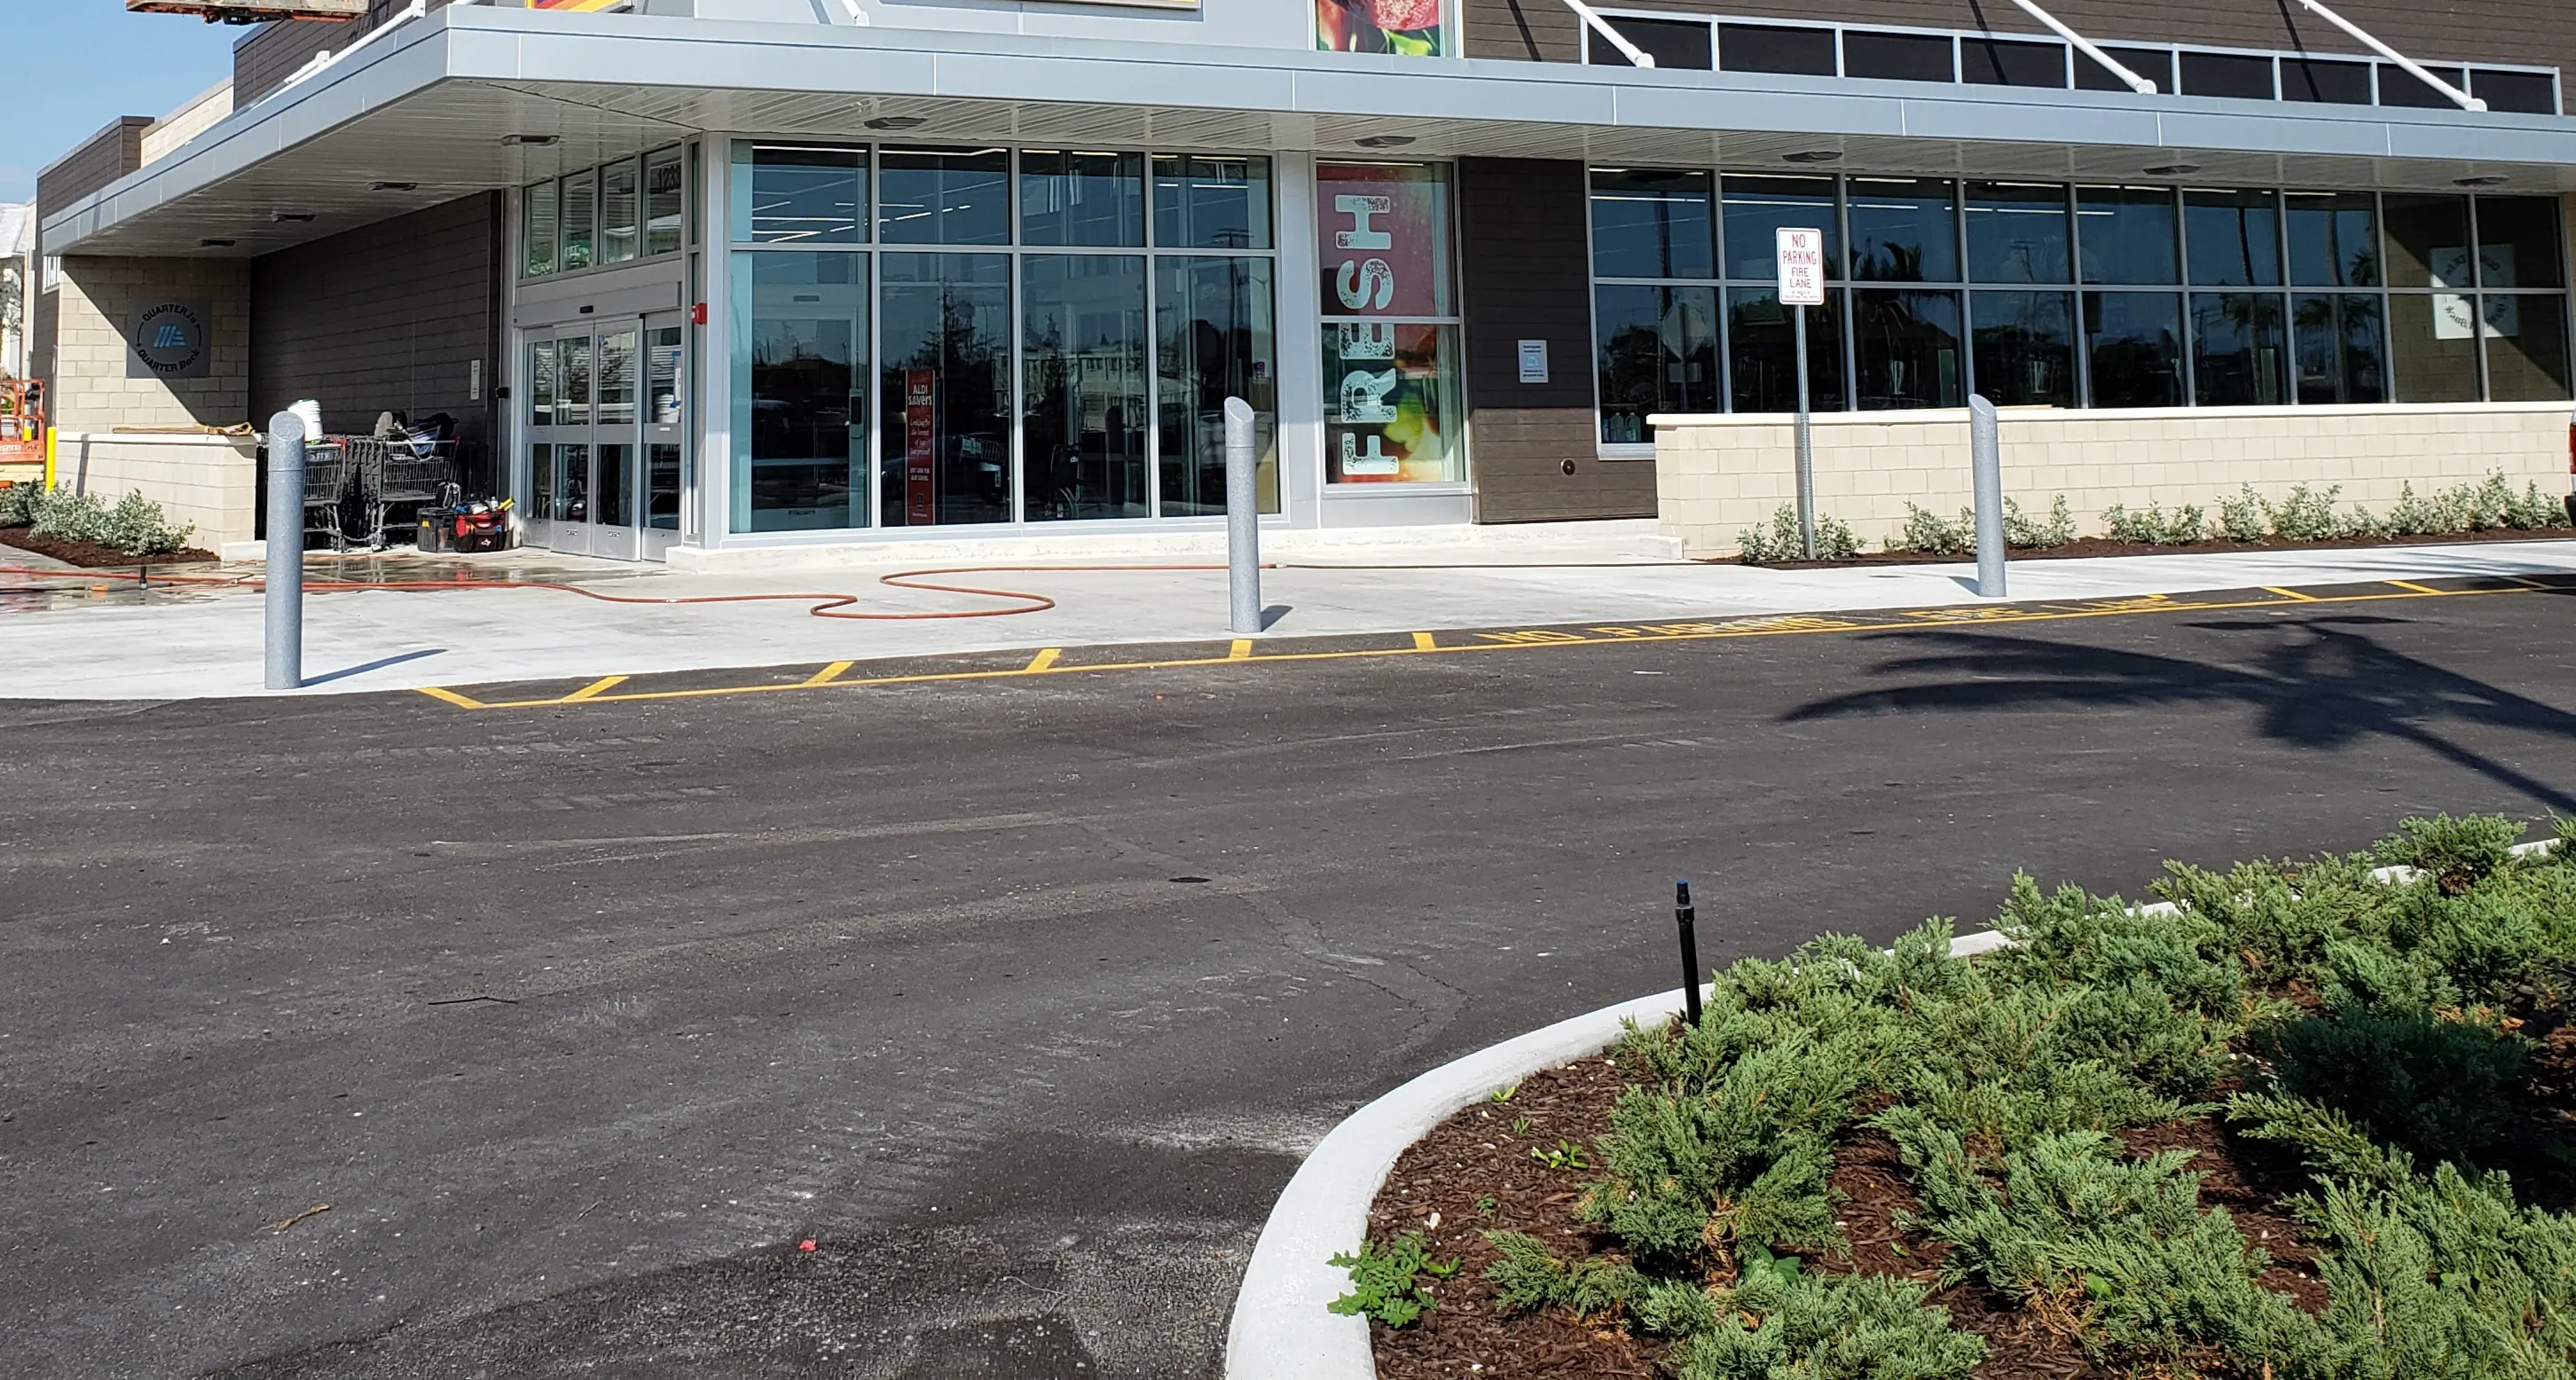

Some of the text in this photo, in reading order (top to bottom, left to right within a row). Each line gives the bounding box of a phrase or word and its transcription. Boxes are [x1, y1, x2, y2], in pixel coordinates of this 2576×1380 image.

[1791, 233, 1806, 248] NO
[1782, 250, 1817, 265] PARKING
[1791, 267, 1810, 278] FIRE
[1789, 278, 1811, 288] LANE
[142, 303, 188, 322] QUARTER
[1334, 193, 1400, 476] FRESH
[137, 349, 200, 372] QUARTER Back
[912, 384, 929, 396] ALDI
[1472, 631, 1586, 644] NO
